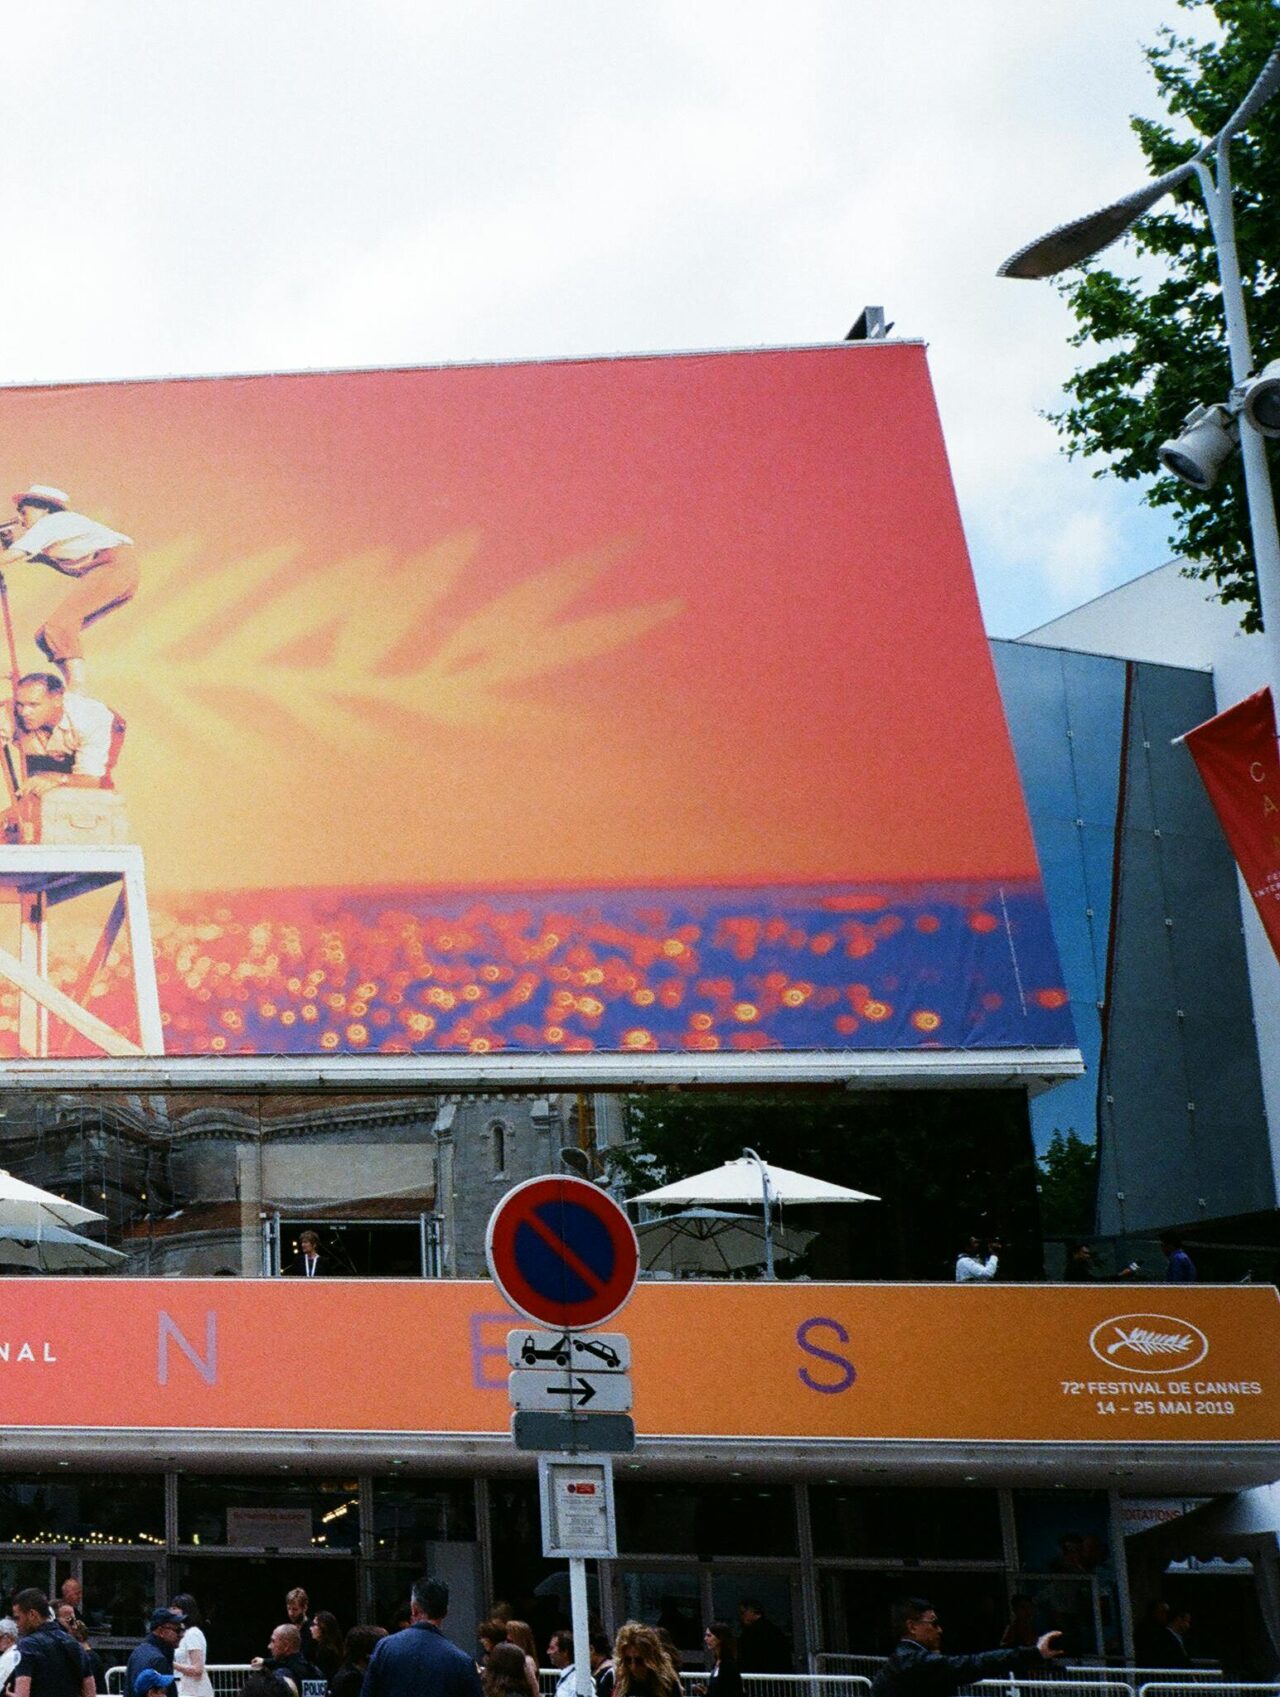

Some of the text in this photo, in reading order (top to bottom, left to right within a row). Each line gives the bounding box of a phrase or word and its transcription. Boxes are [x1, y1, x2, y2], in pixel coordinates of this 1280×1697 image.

[1087, 1381, 1165, 1395] FESTIVAL
[1169, 1381, 1191, 1395] DE
[1194, 1381, 1262, 1395] CANNES
[1096, 1401, 1116, 1415] 14
[1134, 1401, 1155, 1415] 25
[1159, 1401, 1191, 1415] MAI
[1196, 1401, 1235, 1415] 2019
